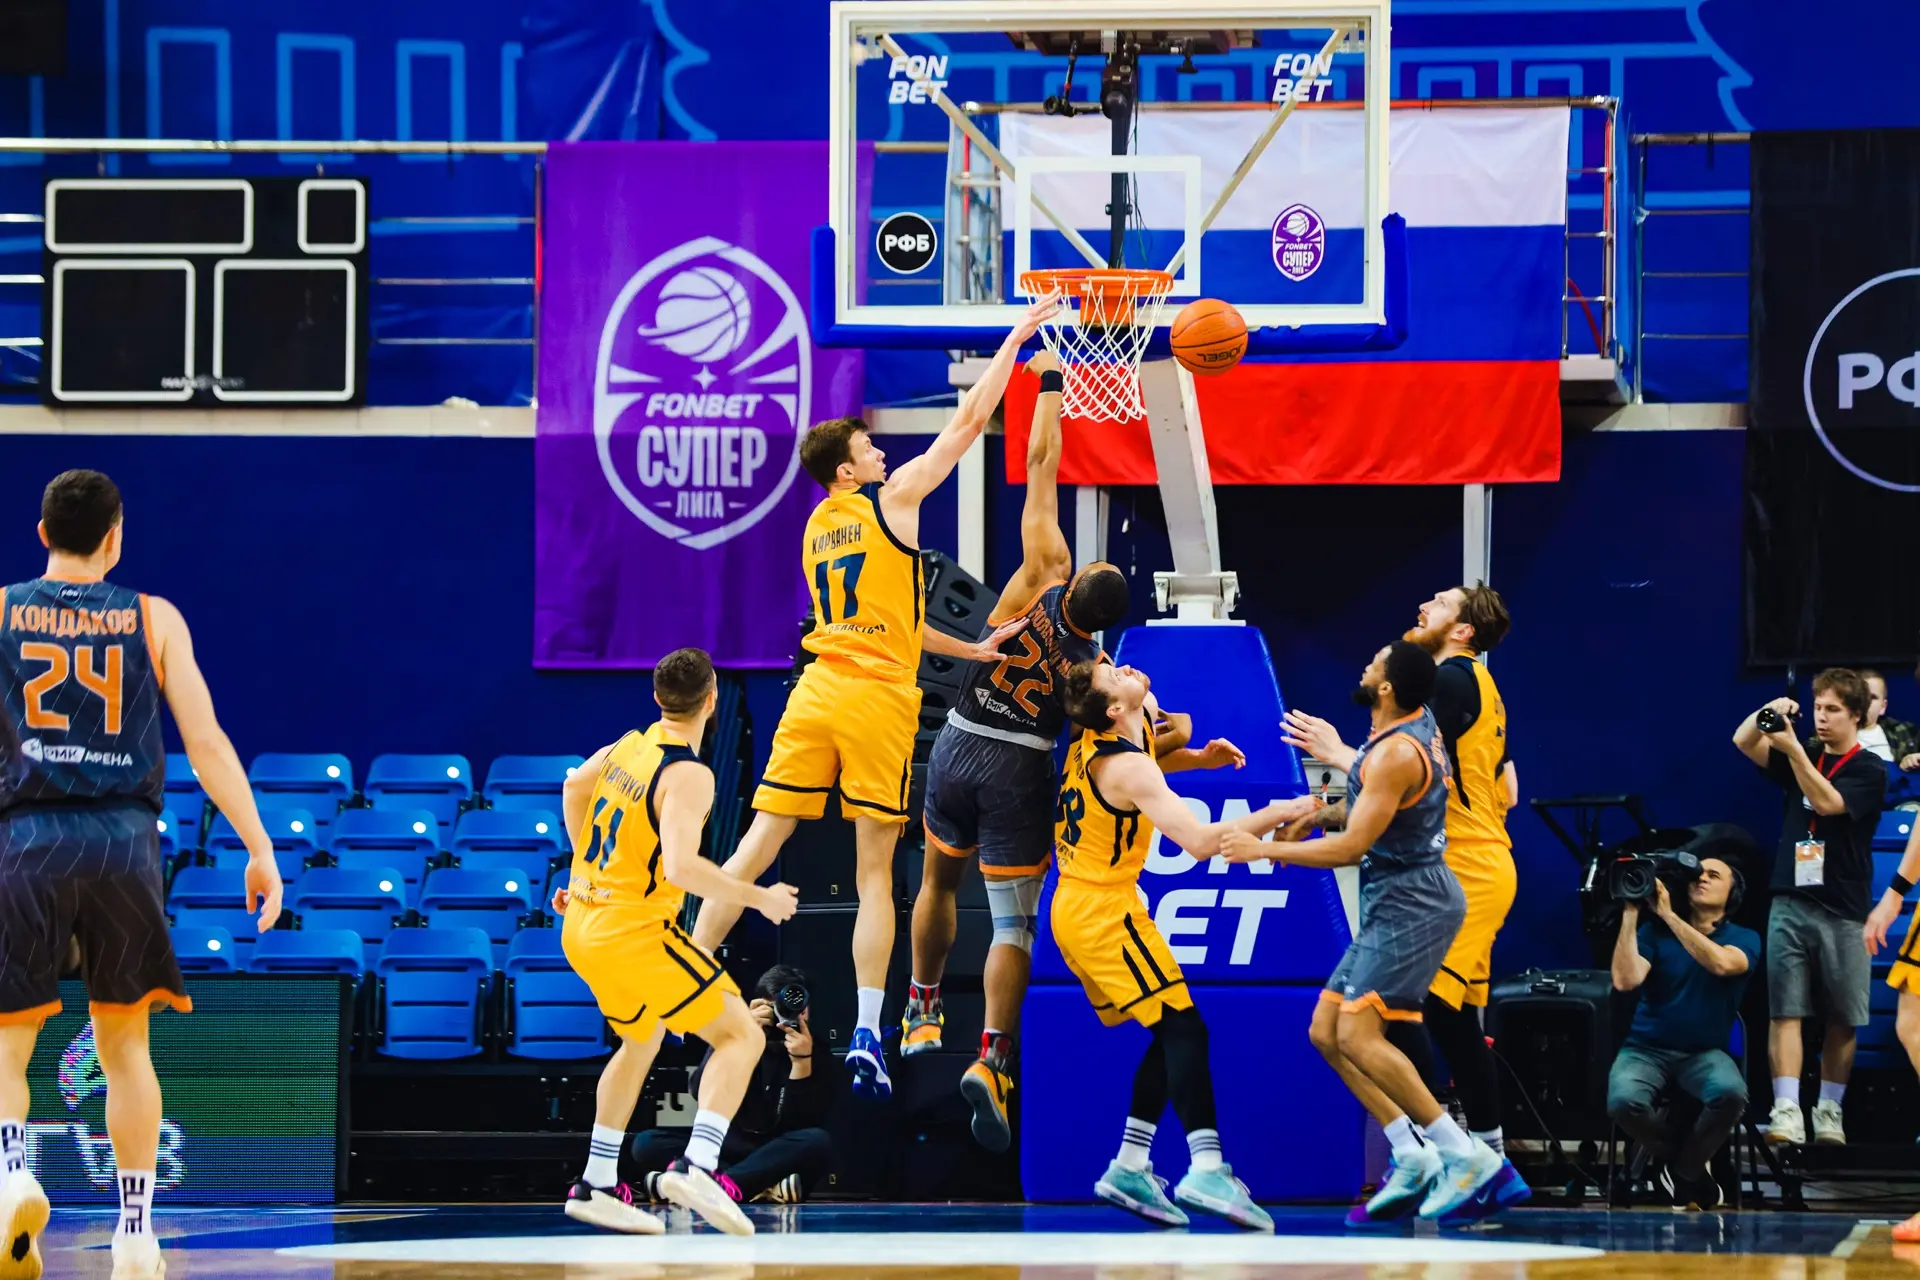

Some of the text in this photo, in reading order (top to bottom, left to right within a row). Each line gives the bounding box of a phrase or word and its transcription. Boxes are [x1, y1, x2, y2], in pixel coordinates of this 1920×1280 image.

[889, 54, 949, 80] FON
[1272, 53, 1334, 77] FON
[888, 80, 949, 104] BET
[1272, 78, 1333, 102] BET
[884, 233, 930, 253] РФБ
[1282, 251, 1315, 268] СУПЕР
[645, 392, 763, 419] FONBET
[636, 424, 768, 488] СУПЕР
[675, 490, 725, 519] ЛИГА
[815, 552, 867, 625] 17
[9, 604, 138, 638] КОНДАКОВ
[990, 630, 1053, 718] 22
[20, 641, 124, 735] 24
[84, 751, 133, 767] АРЕНА
[1137, 884, 1289, 965] ET
